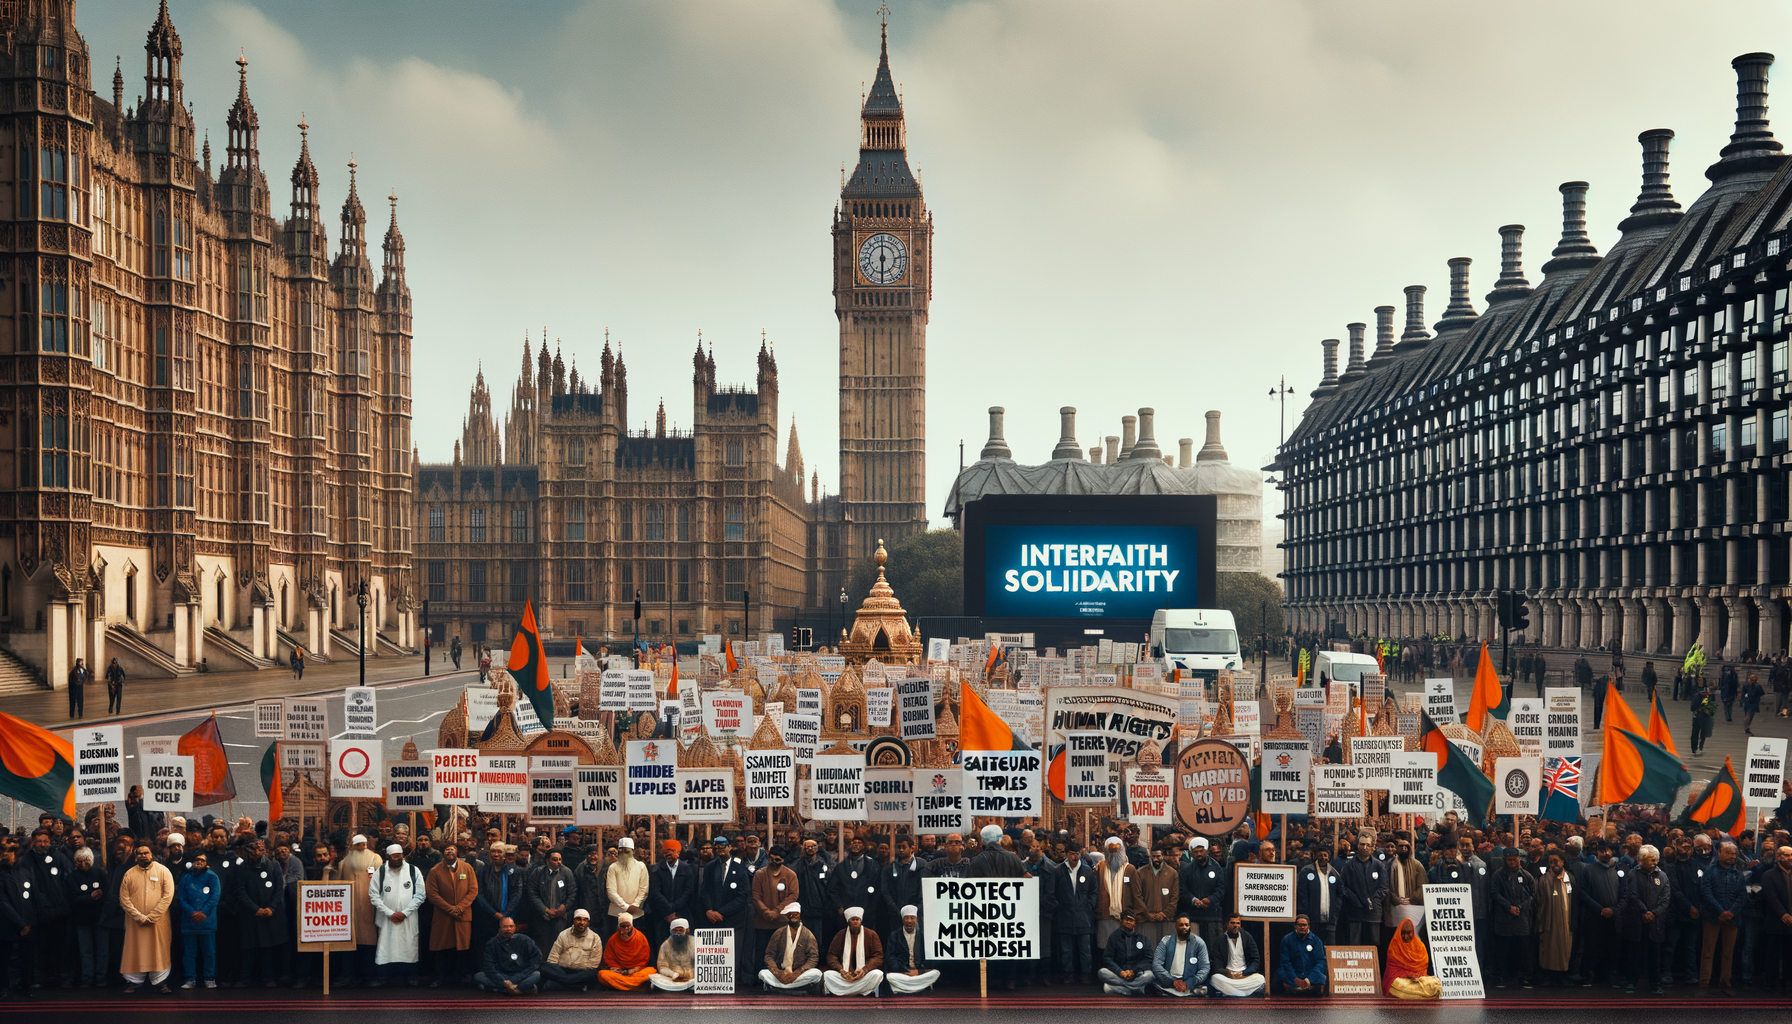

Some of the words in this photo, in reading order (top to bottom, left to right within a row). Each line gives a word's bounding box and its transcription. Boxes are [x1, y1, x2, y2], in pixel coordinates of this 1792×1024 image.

[1021, 544, 1167, 566] INTERFAITH
[967, 796, 1032, 811] TEMPLES
[936, 882, 1024, 900] PROTECT
[949, 902, 1016, 920] HINDU
[934, 940, 954, 958] IN
[960, 939, 1031, 958] THDESH
